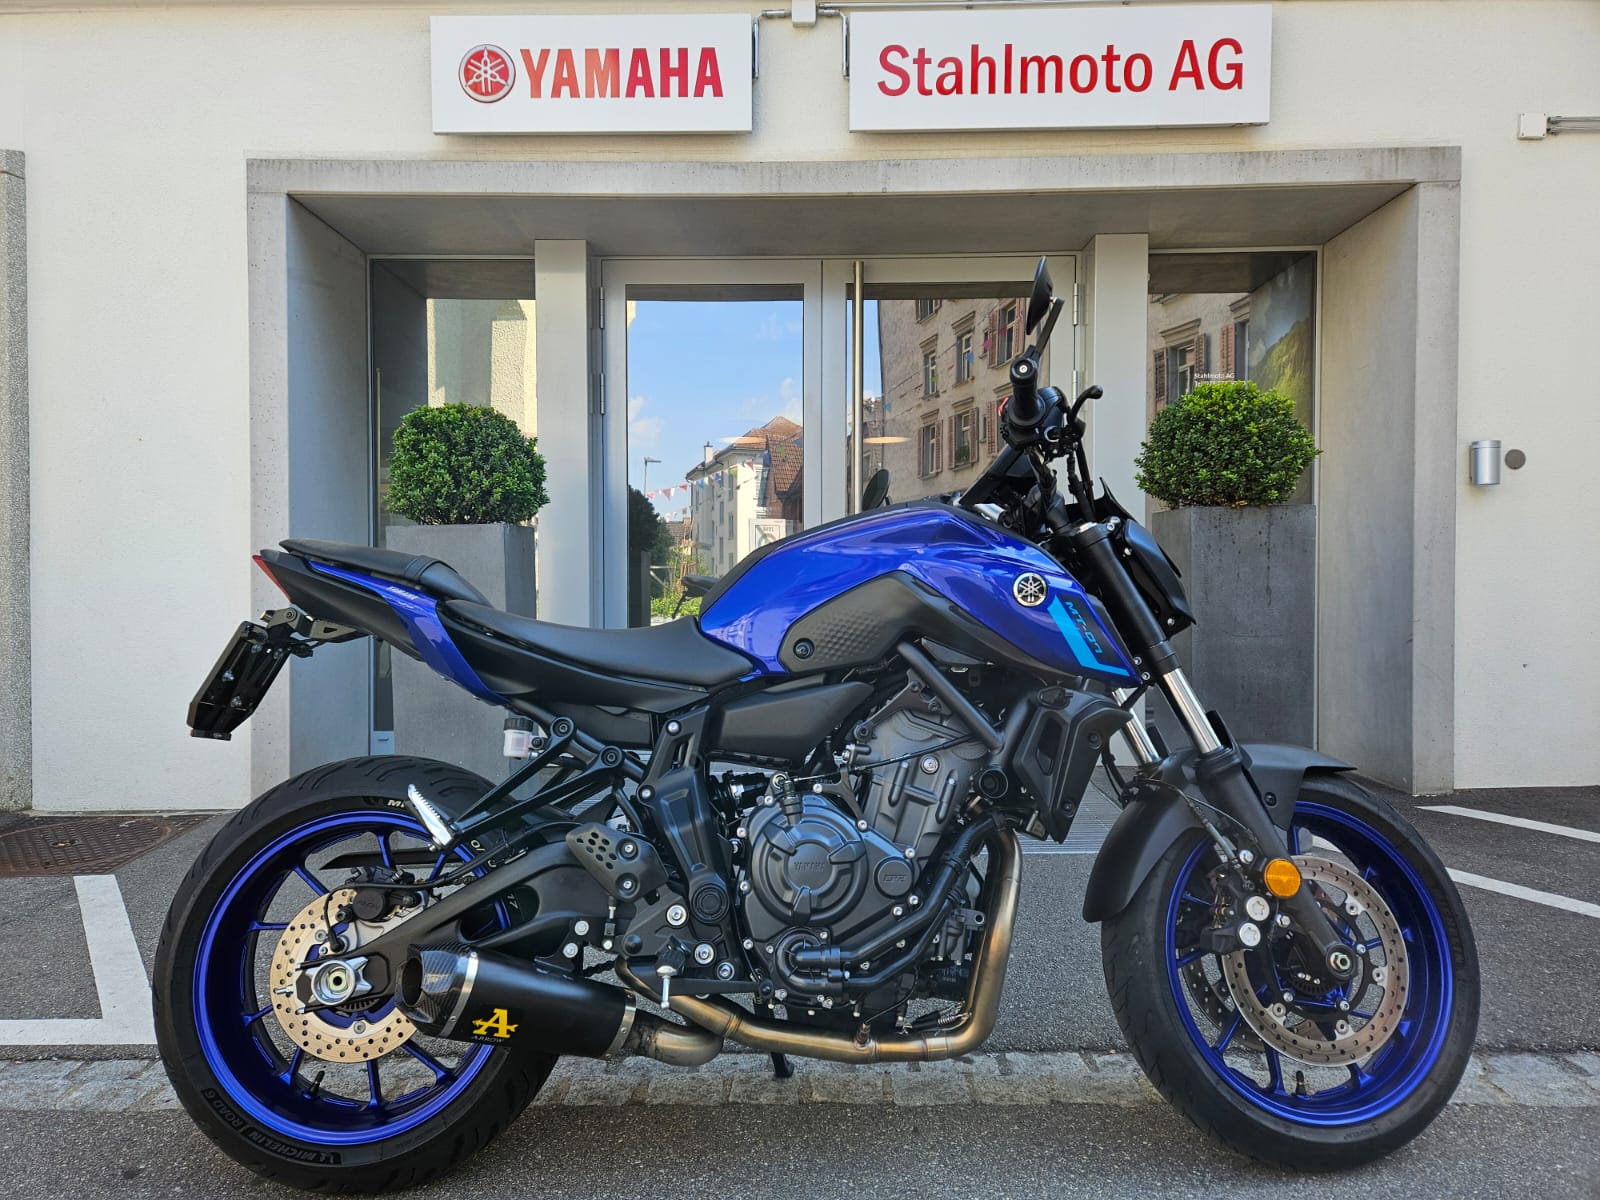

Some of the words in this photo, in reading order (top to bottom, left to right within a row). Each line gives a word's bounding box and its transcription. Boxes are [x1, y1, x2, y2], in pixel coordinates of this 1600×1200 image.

[520, 47, 724, 98] YAMAHA
[877, 43, 1153, 97] Stahlmoto
[1168, 37, 1244, 91] AG
[1065, 601, 1103, 654] MT-07
[794, 862, 825, 872] YAMAHA
[213, 1099, 243, 1128] ROAD
[247, 1130, 317, 1161] MICHELIN
